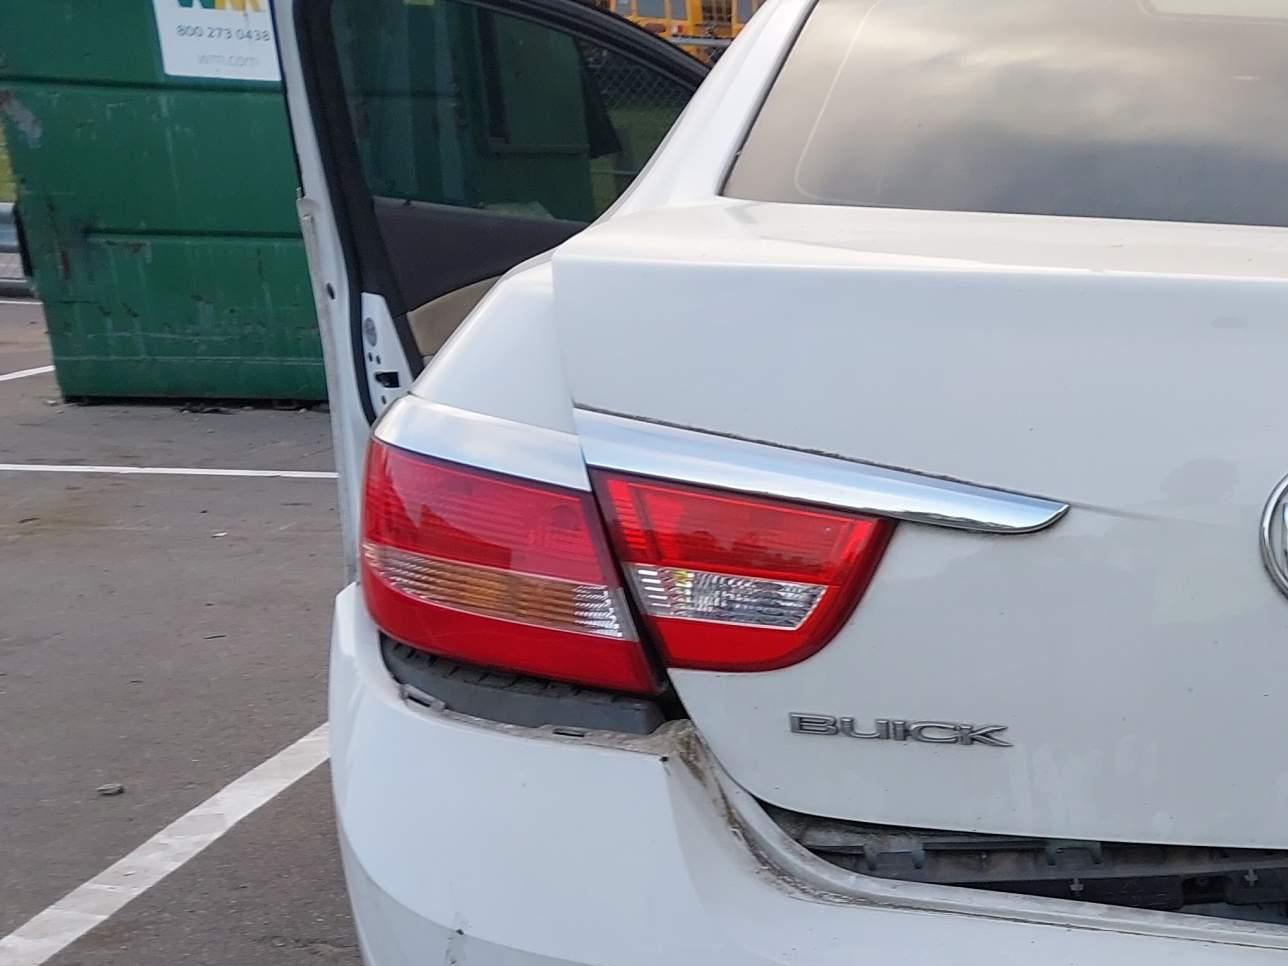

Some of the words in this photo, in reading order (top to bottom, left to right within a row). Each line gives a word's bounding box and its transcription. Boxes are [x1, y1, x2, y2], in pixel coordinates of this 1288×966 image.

[176, 24, 203, 38] 800
[207, 26, 232, 40] 273
[236, 29, 271, 42] 0438
[789, 711, 1014, 748] BUICK
